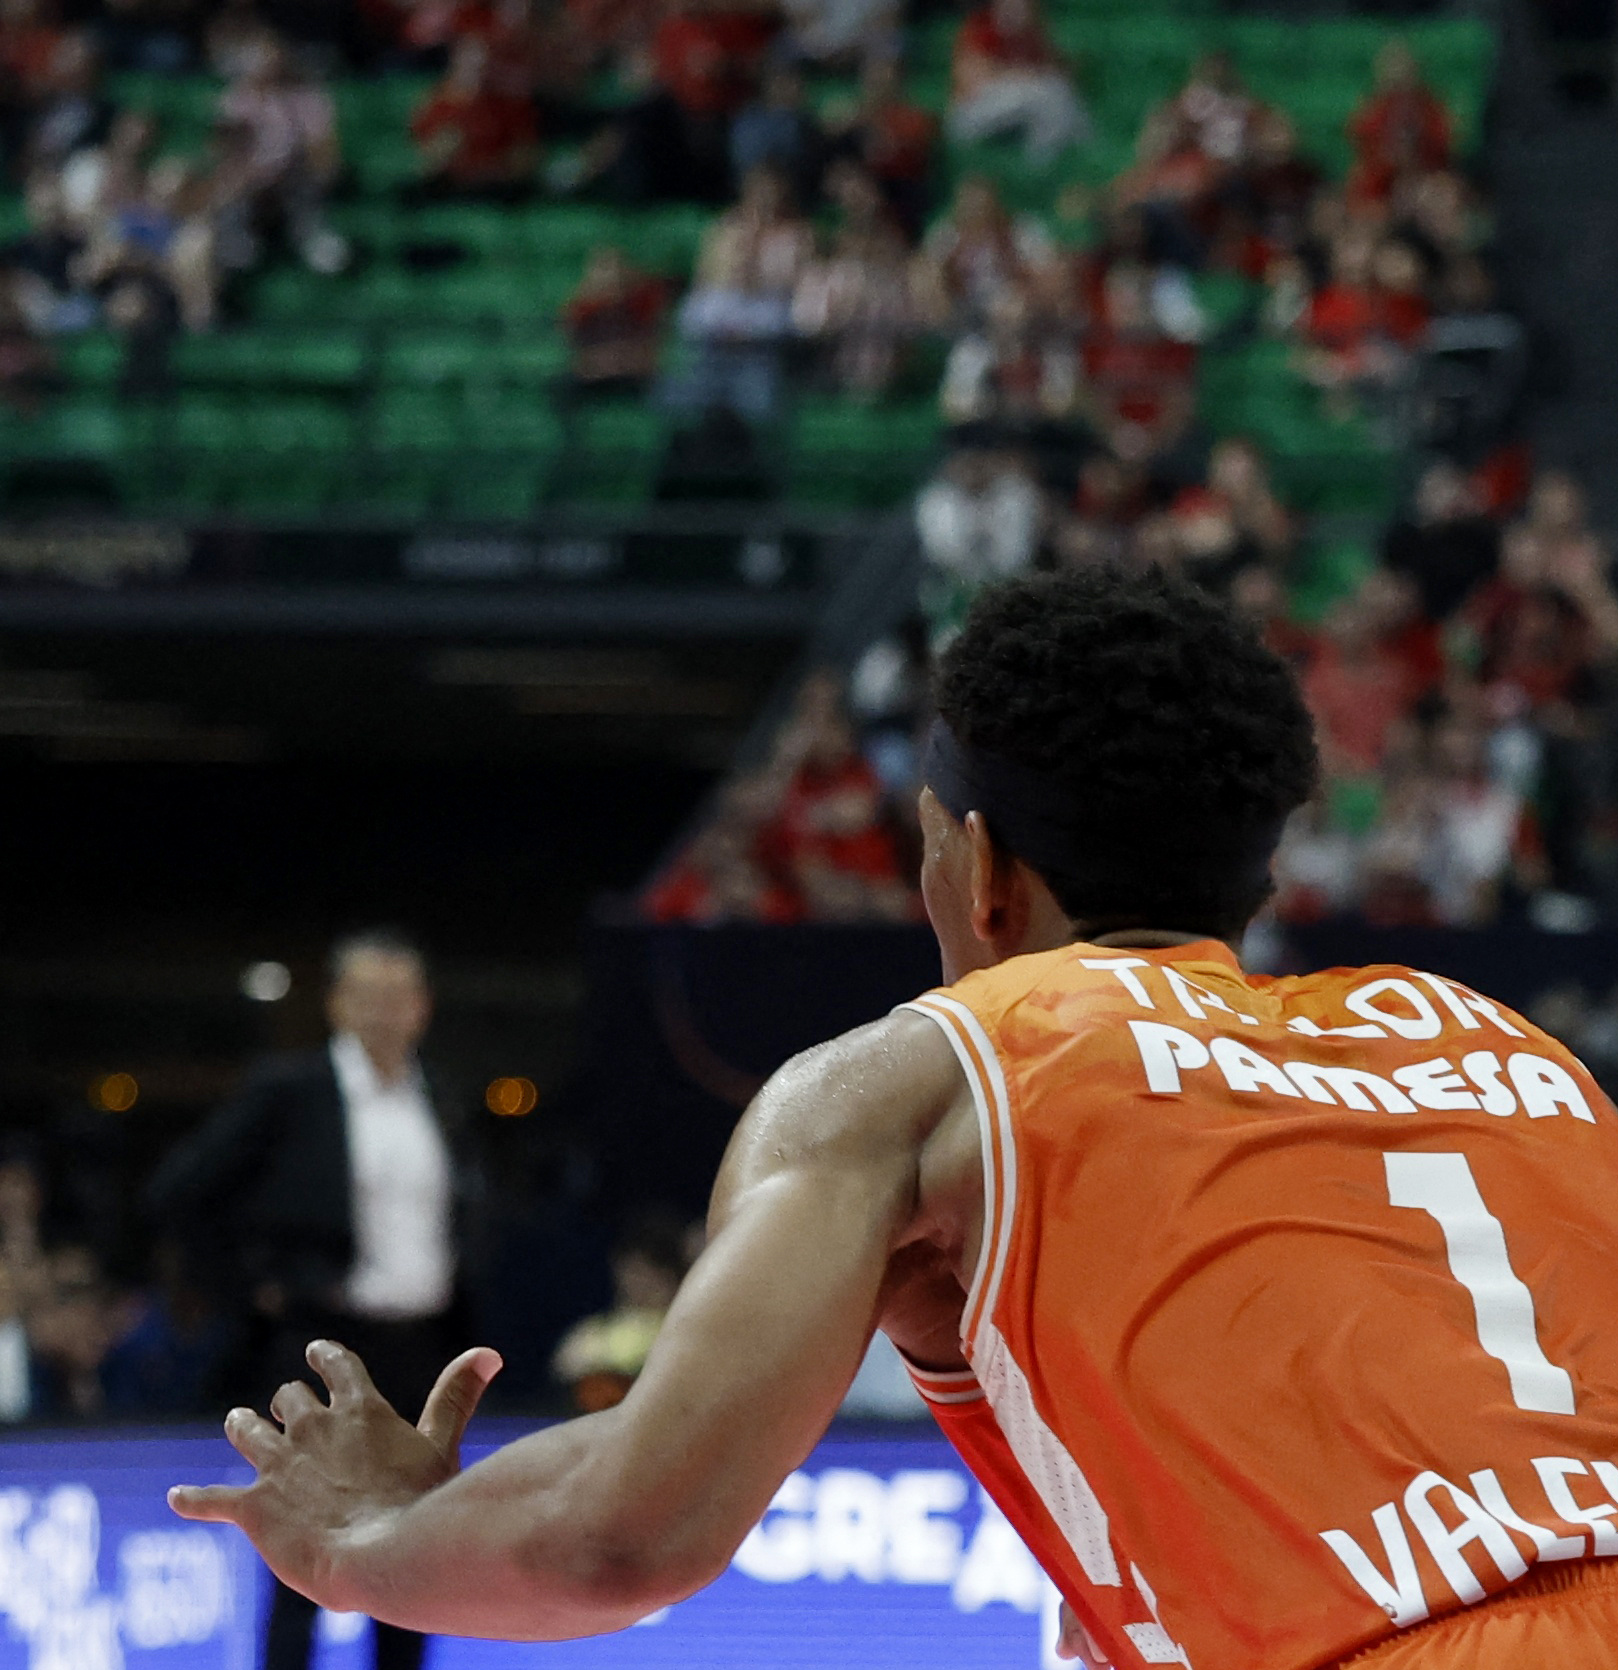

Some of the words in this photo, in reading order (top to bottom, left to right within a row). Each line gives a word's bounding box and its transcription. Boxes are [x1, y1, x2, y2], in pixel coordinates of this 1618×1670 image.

[1078, 957, 1527, 1041] TALOR
[1126, 1019, 1597, 1125] PAMESA
[1383, 1152, 1576, 1416] 1
